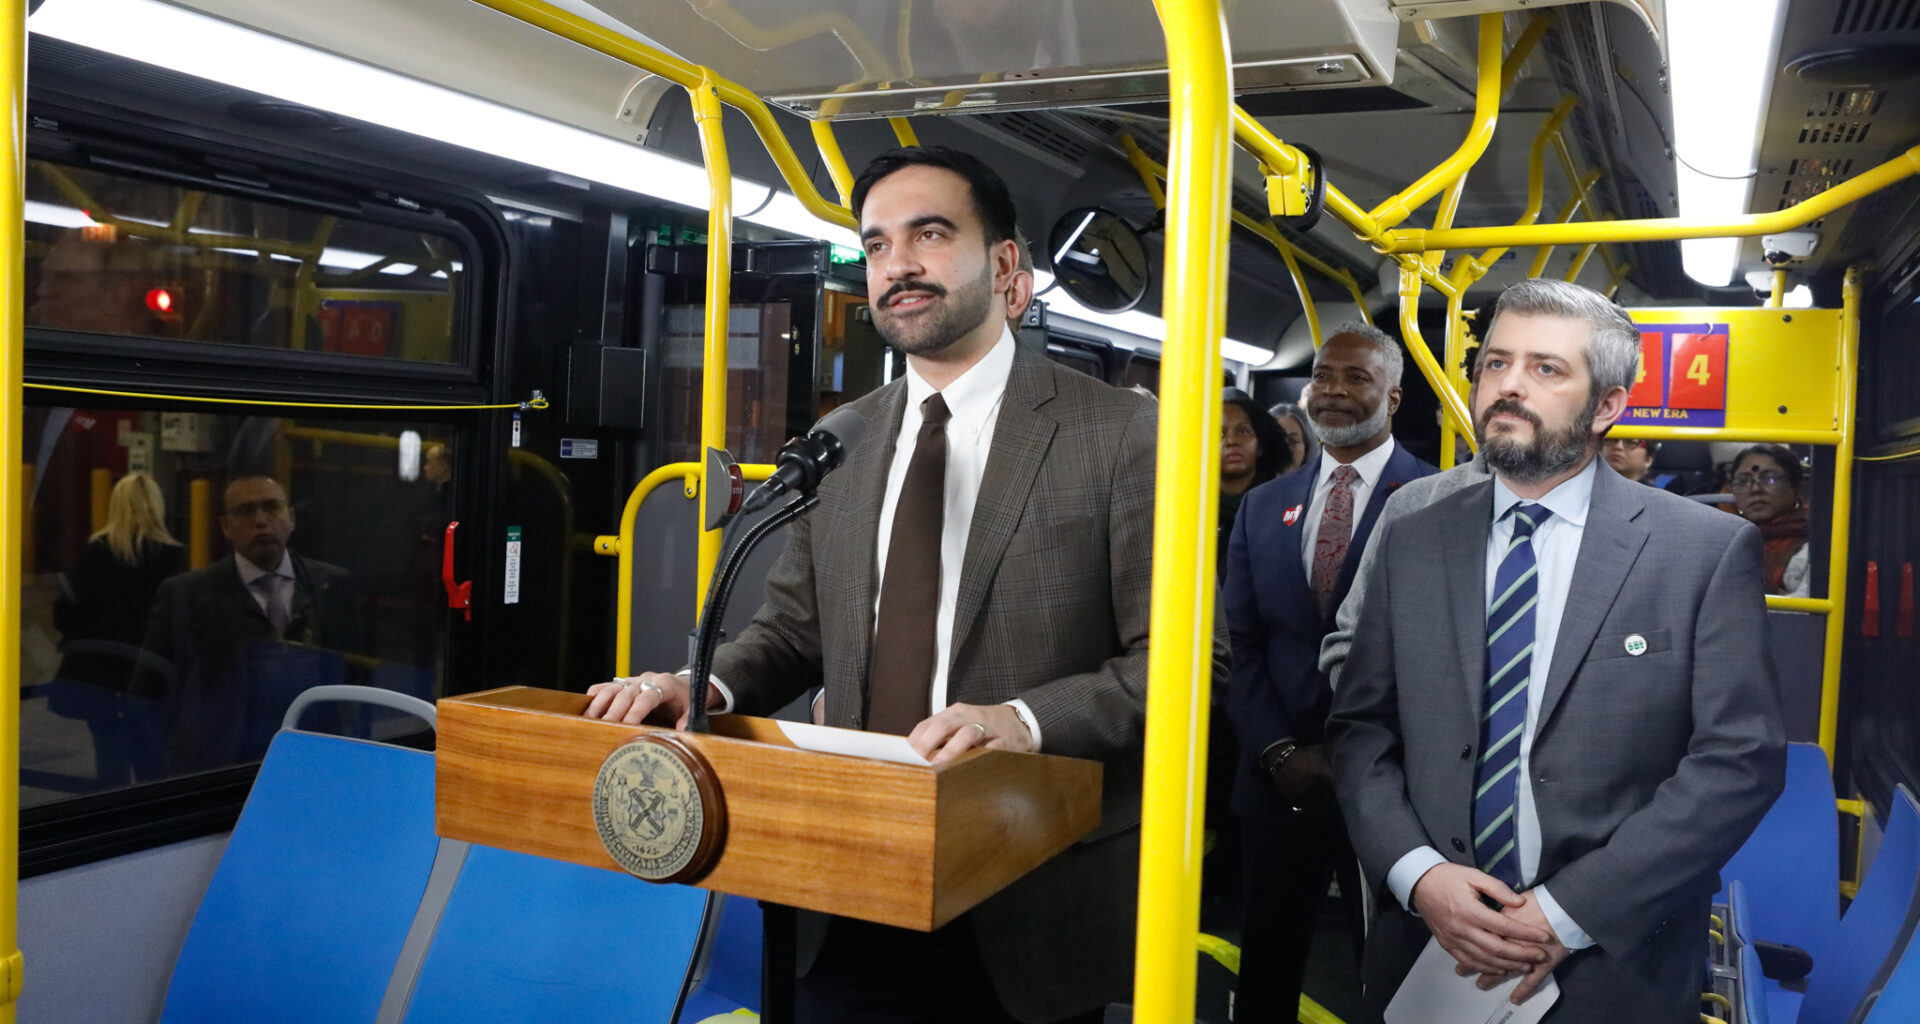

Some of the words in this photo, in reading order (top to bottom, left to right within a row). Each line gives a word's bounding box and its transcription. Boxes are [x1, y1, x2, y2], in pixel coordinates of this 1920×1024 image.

[1686, 354, 1711, 386] 4
[1632, 408, 1662, 418] NEW
[1663, 408, 1689, 419] ERA
